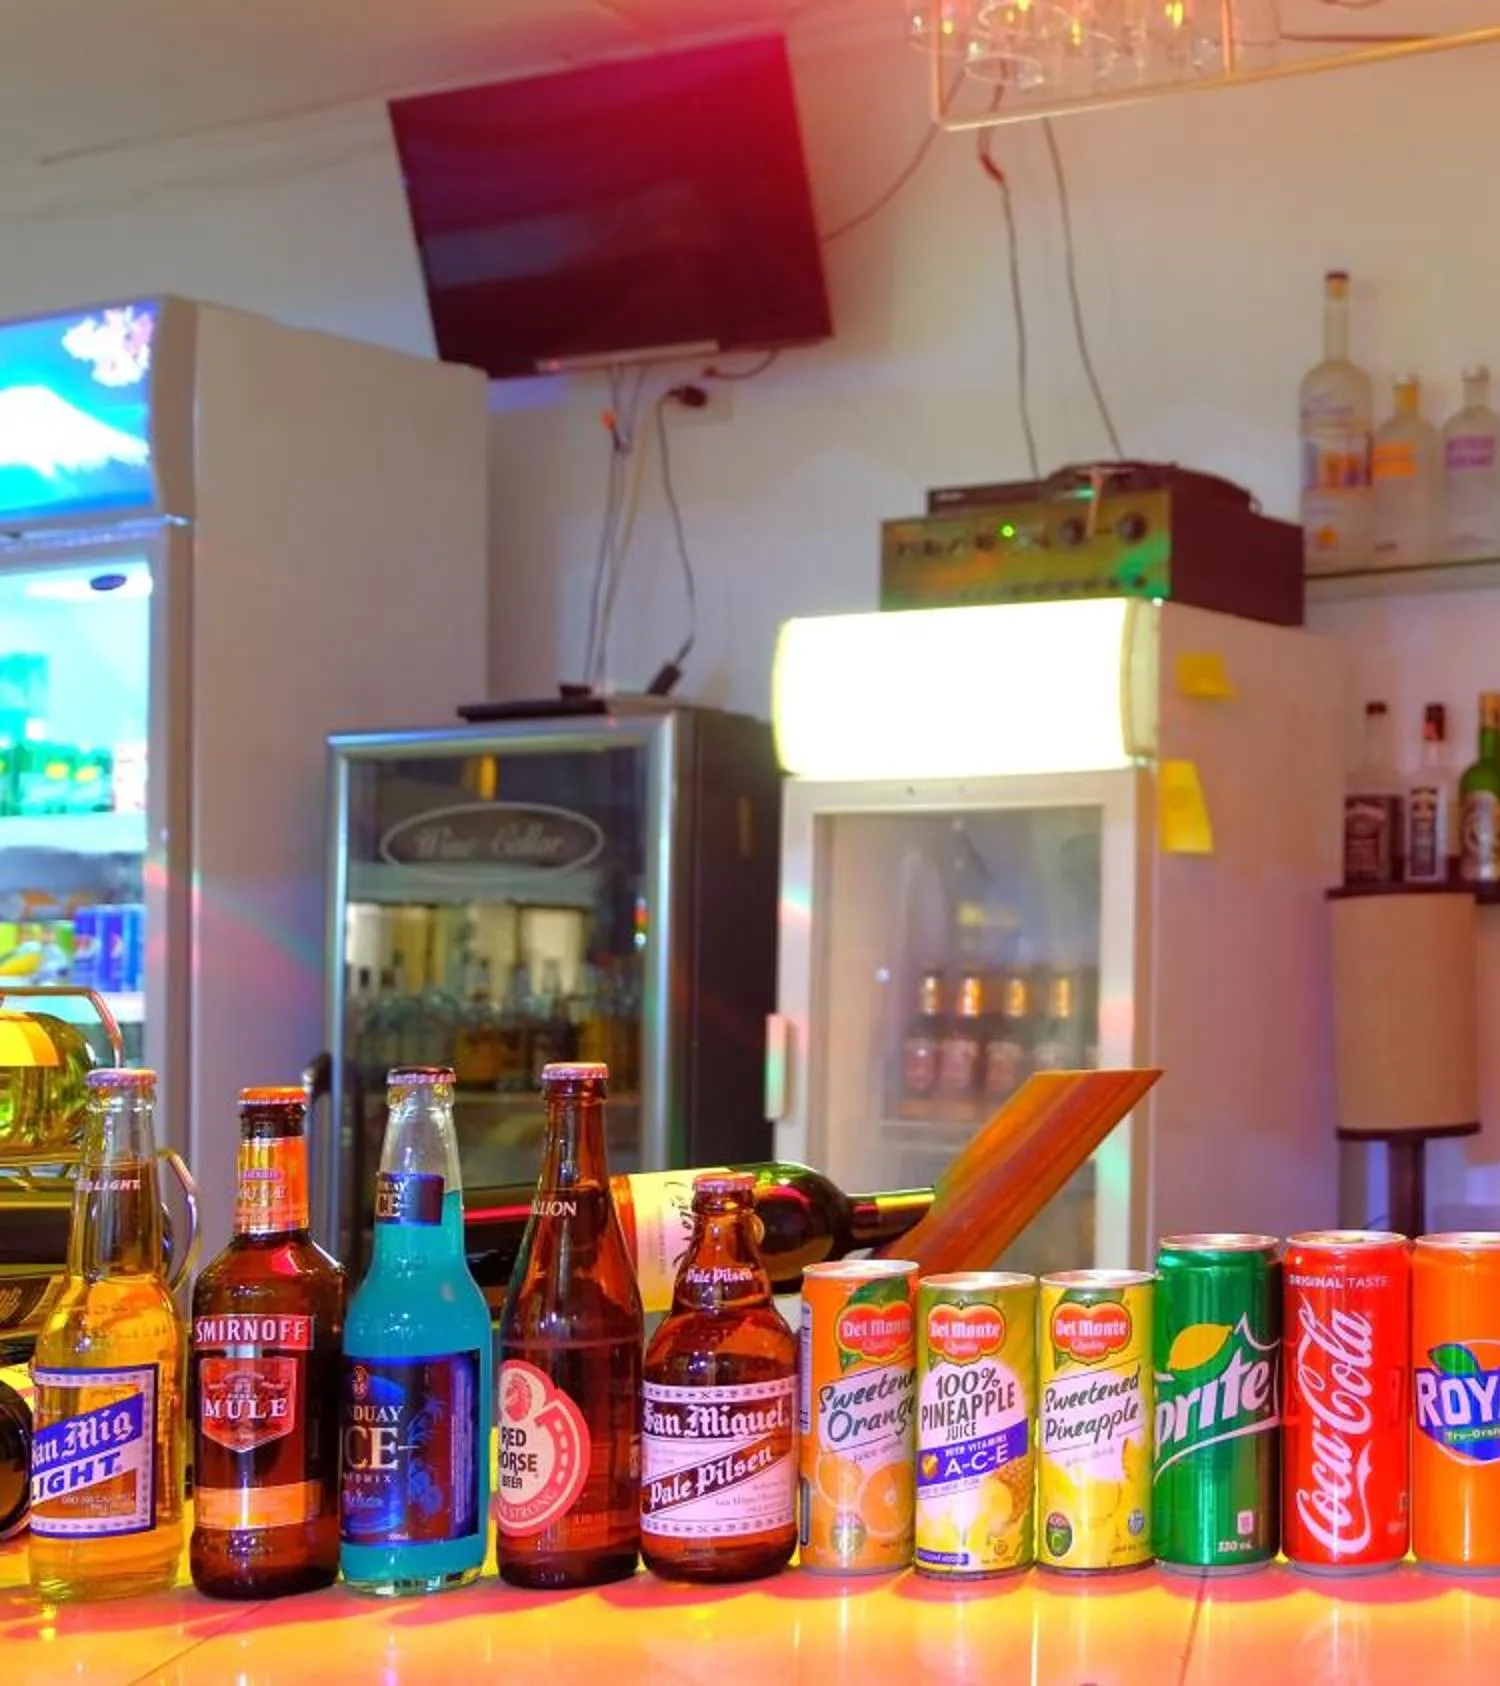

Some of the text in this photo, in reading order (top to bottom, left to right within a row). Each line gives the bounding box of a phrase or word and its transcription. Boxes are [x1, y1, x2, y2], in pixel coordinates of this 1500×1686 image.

[687, 1265, 754, 1284] Pale Pilsen
[1346, 1275, 1390, 1289] TASTE
[195, 1319, 306, 1343] SMIRNOFF
[842, 1320, 867, 1337] Del
[930, 1320, 1001, 1338] Del Monte
[1056, 1320, 1127, 1337] Del Monte
[936, 1367, 1000, 1401] 100%
[1045, 1363, 1141, 1414] Sweetened
[203, 1397, 288, 1420] MULE
[643, 1397, 783, 1440] San Miguel
[921, 1382, 1015, 1432] PINEAPPLE
[1044, 1397, 1139, 1445] Pineapple
[1153, 1348, 1271, 1464] prite
[61, 1410, 135, 1458] Mig
[945, 1422, 977, 1442] JUICE
[1295, 1291, 1374, 1560] Coca-Cola
[499, 1450, 538, 1476] ORSE
[944, 1443, 1009, 1478] A-C-E
[650, 1473, 693, 1510] Pale
[695, 1446, 772, 1496] Pilsen
